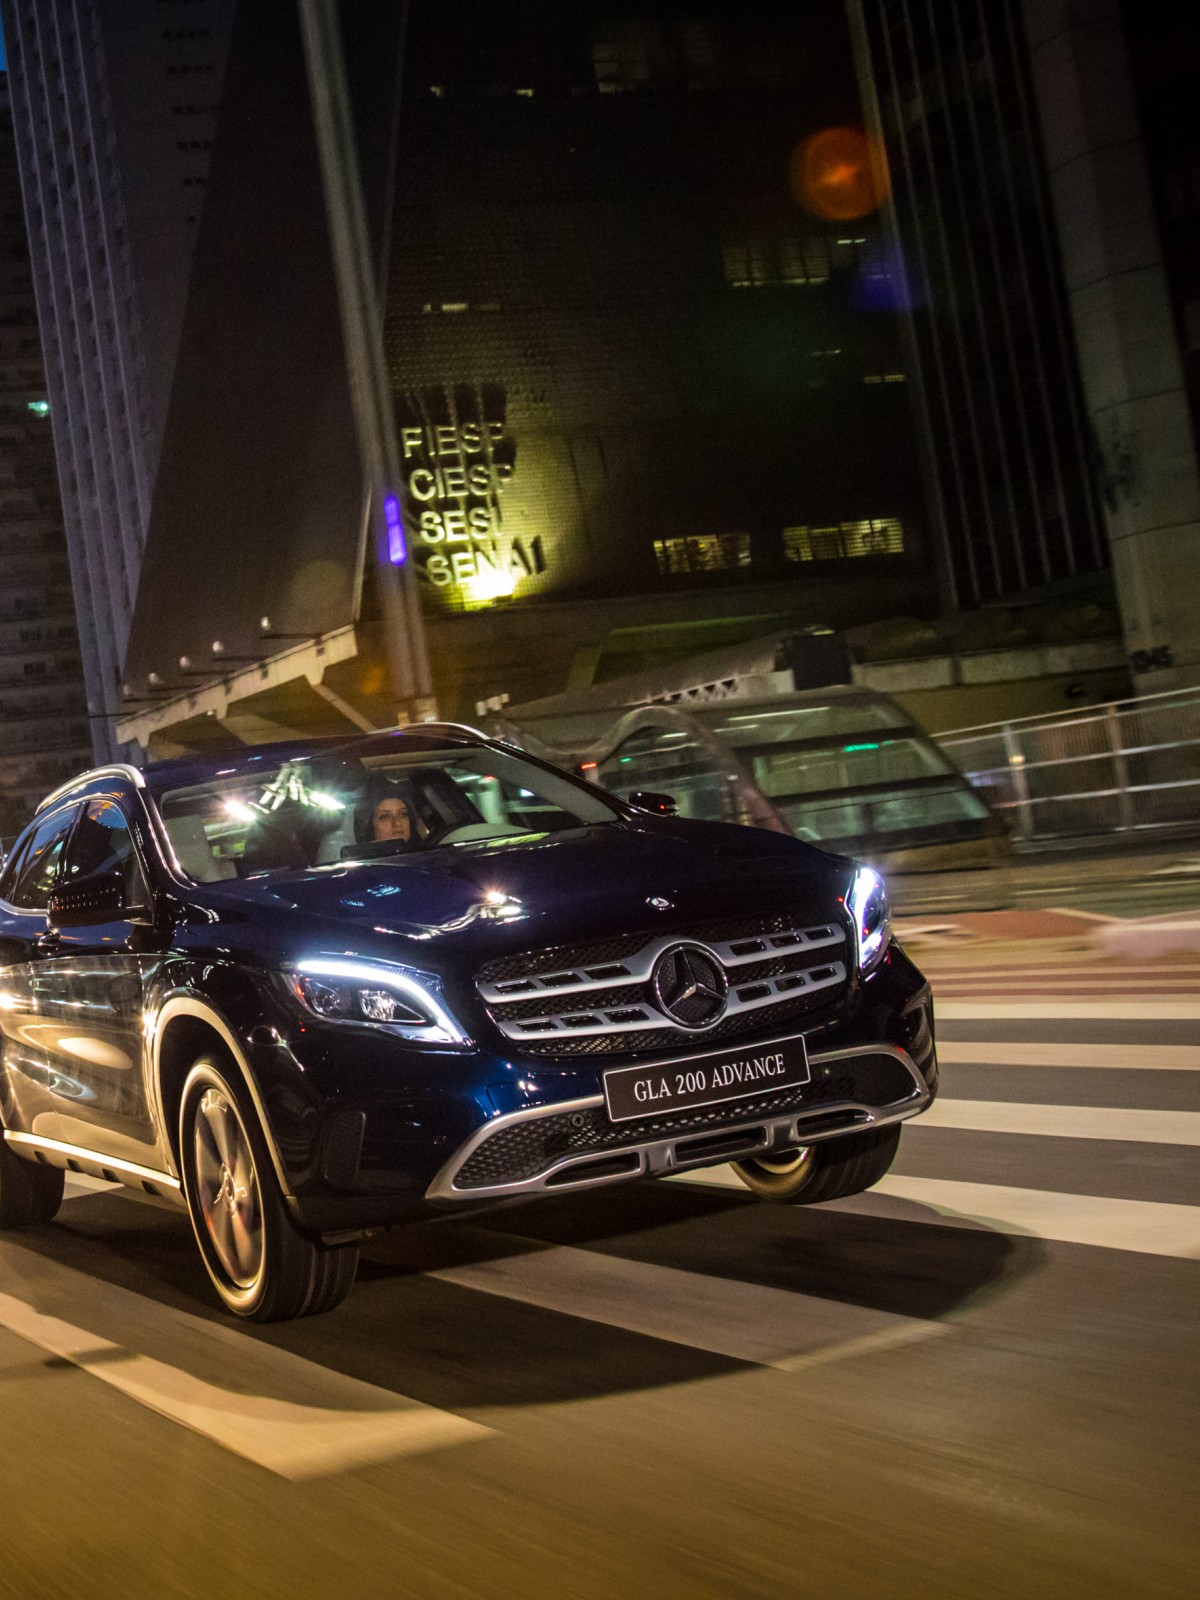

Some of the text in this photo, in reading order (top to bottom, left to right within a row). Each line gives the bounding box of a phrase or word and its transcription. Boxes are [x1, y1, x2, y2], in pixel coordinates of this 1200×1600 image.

[401, 422, 504, 458] FIESP
[409, 463, 513, 501] CIESP
[420, 506, 502, 544] SESI
[426, 538, 541, 587] SENAI
[634, 1053, 786, 1102] GLA 200 ADVANCE
